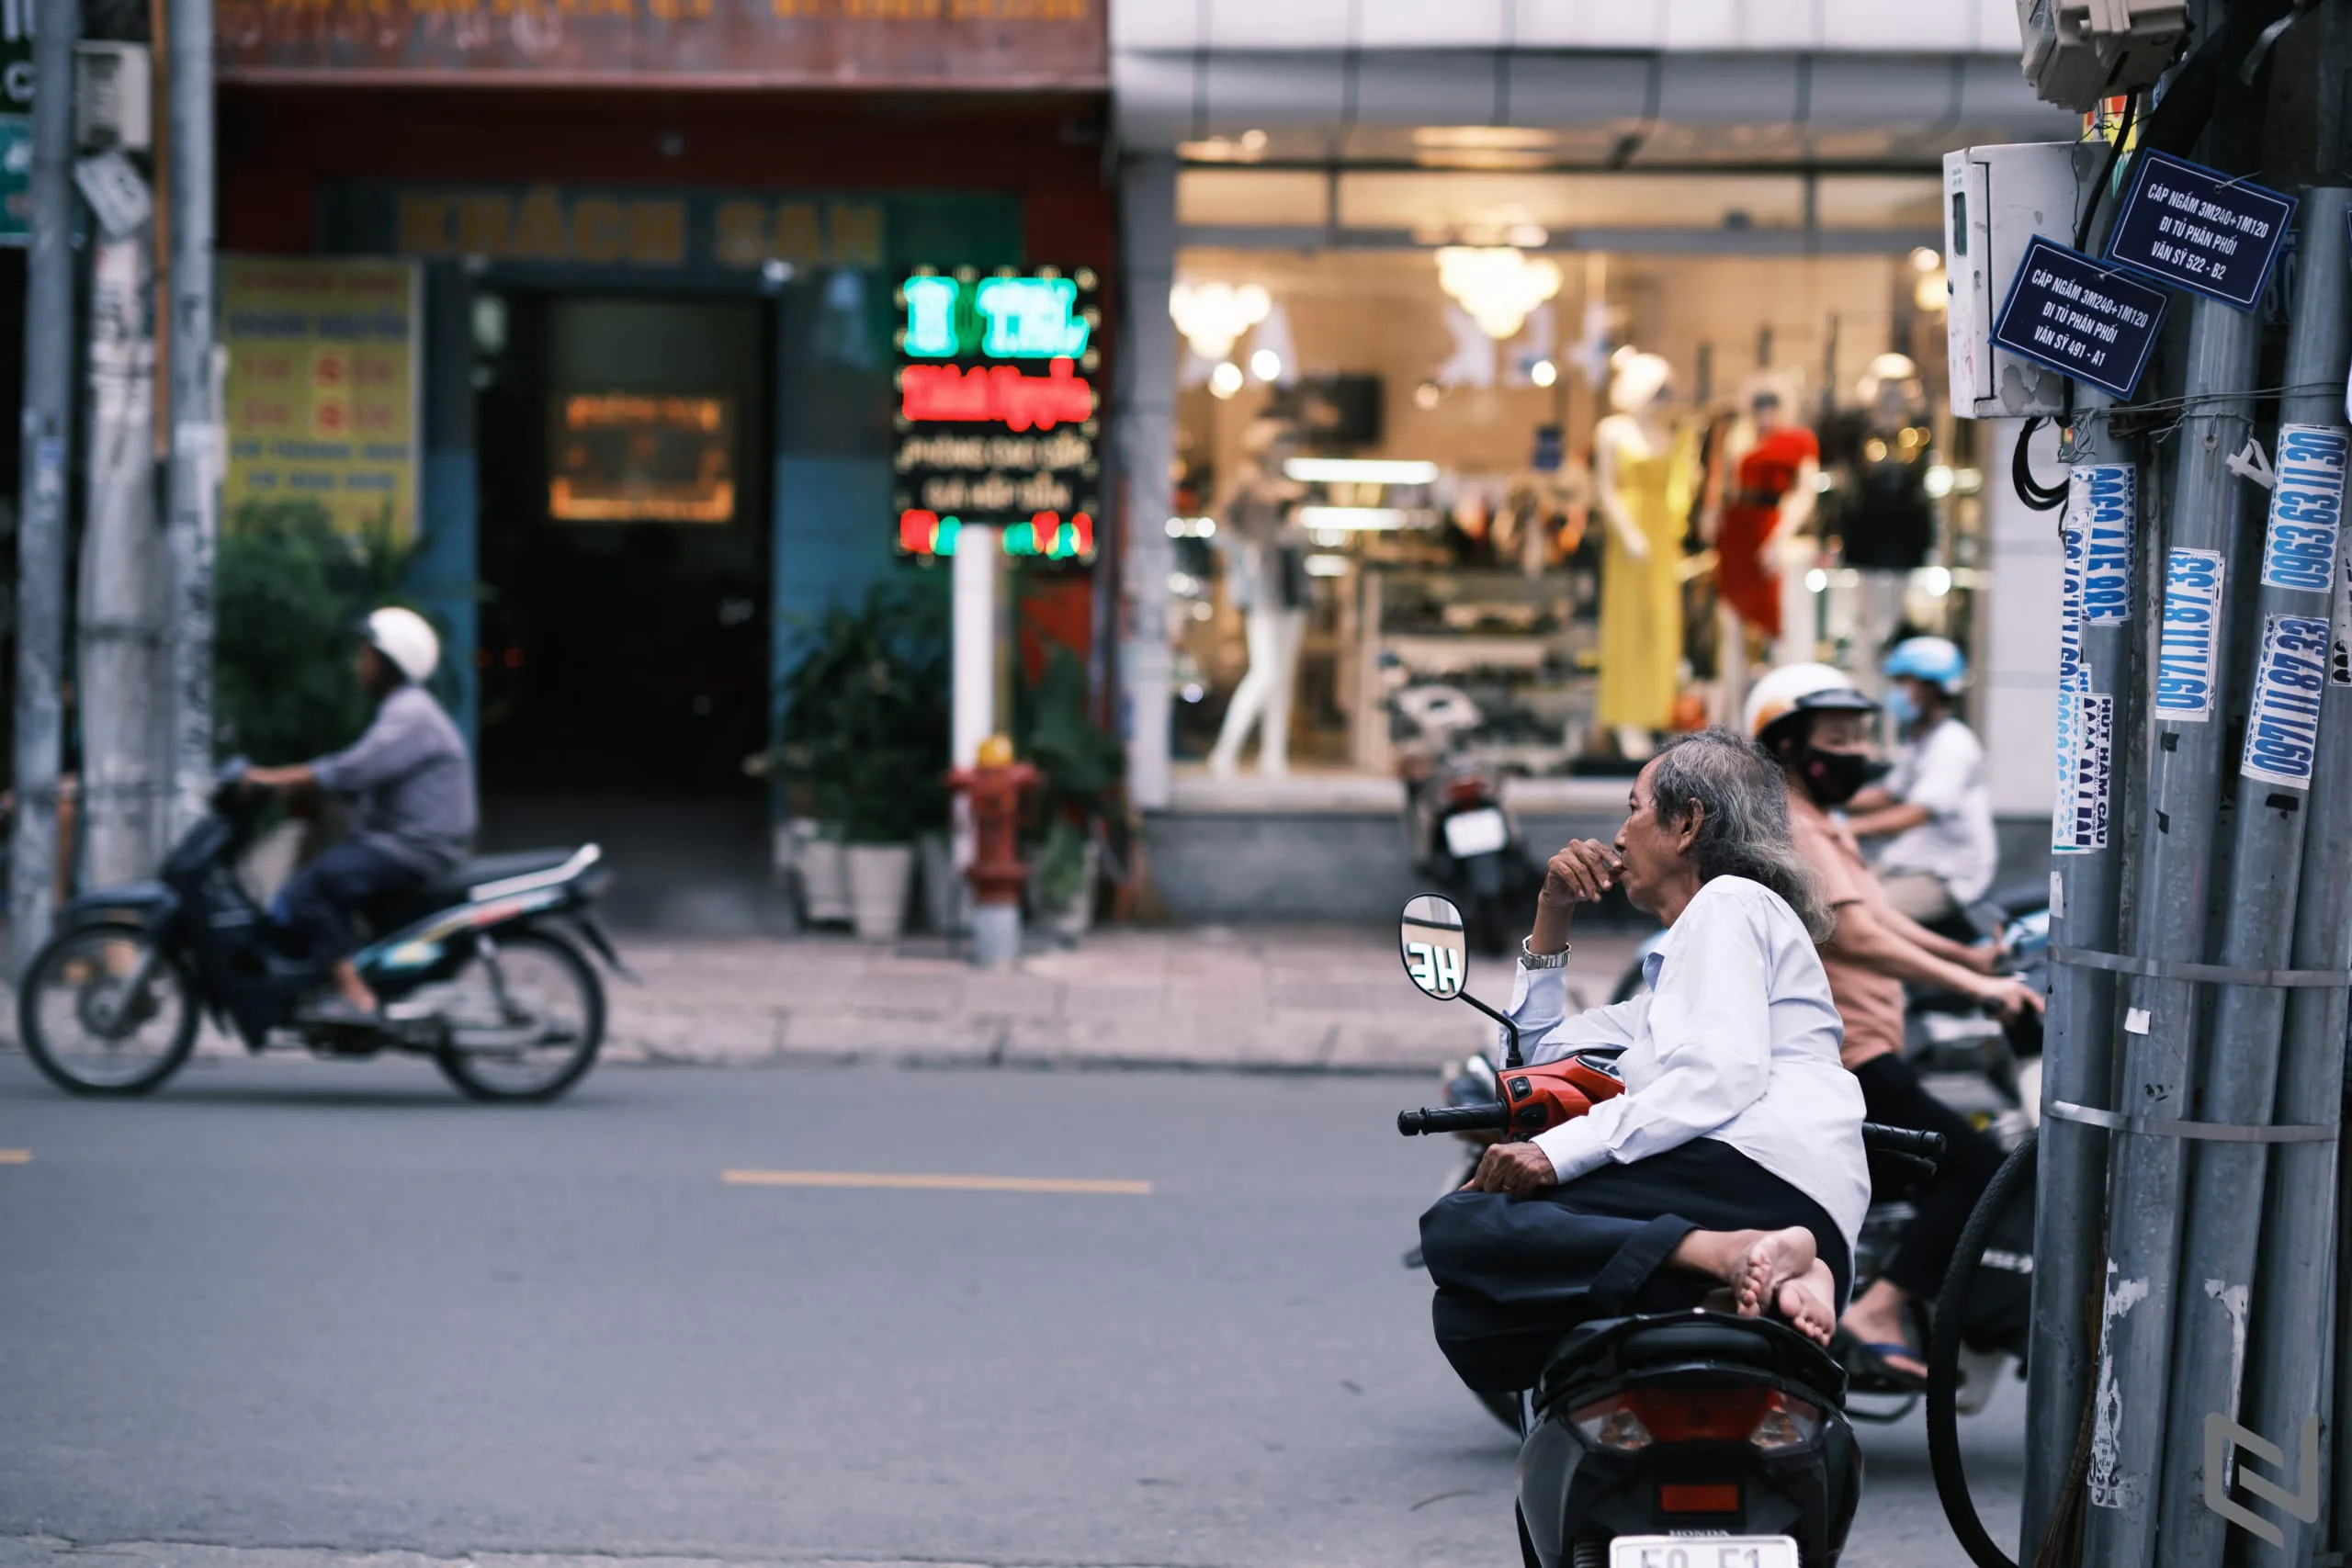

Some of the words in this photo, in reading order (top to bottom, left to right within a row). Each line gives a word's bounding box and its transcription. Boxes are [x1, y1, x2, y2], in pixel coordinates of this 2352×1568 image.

[2147, 183, 2169, 202] CÁP
[2199, 201, 2269, 239] 3M240+1M120
[2159, 216, 2172, 232] ĐI
[2172, 217, 2187, 237] TỦ
[2185, 224, 2213, 248] PHÂN
[2211, 234, 2238, 256] PHỐI
[2151, 241, 2174, 261] VĂN
[2186, 254, 2206, 273] 522
[2211, 262, 2227, 280] B2
[2031, 269, 2052, 288] CÁP
[2080, 289, 2149, 328] 3M240+1M120
[2042, 301, 2055, 318] ĐI
[2054, 302, 2069, 322] TỦ
[2067, 311, 2096, 334] PHÂN
[2093, 322, 2119, 344] PHỐI
[2034, 325, 2056, 346] VĂN
[2068, 339, 2086, 359] 491
[2090, 350, 2106, 367] A1
[2269, 433, 2346, 588] 0963.63.11.30
[2156, 557, 2216, 708] 0971.11.87.33
[2100, 698, 2112, 742] HÚT
[2252, 619, 2327, 776] 0971.11.87.33
